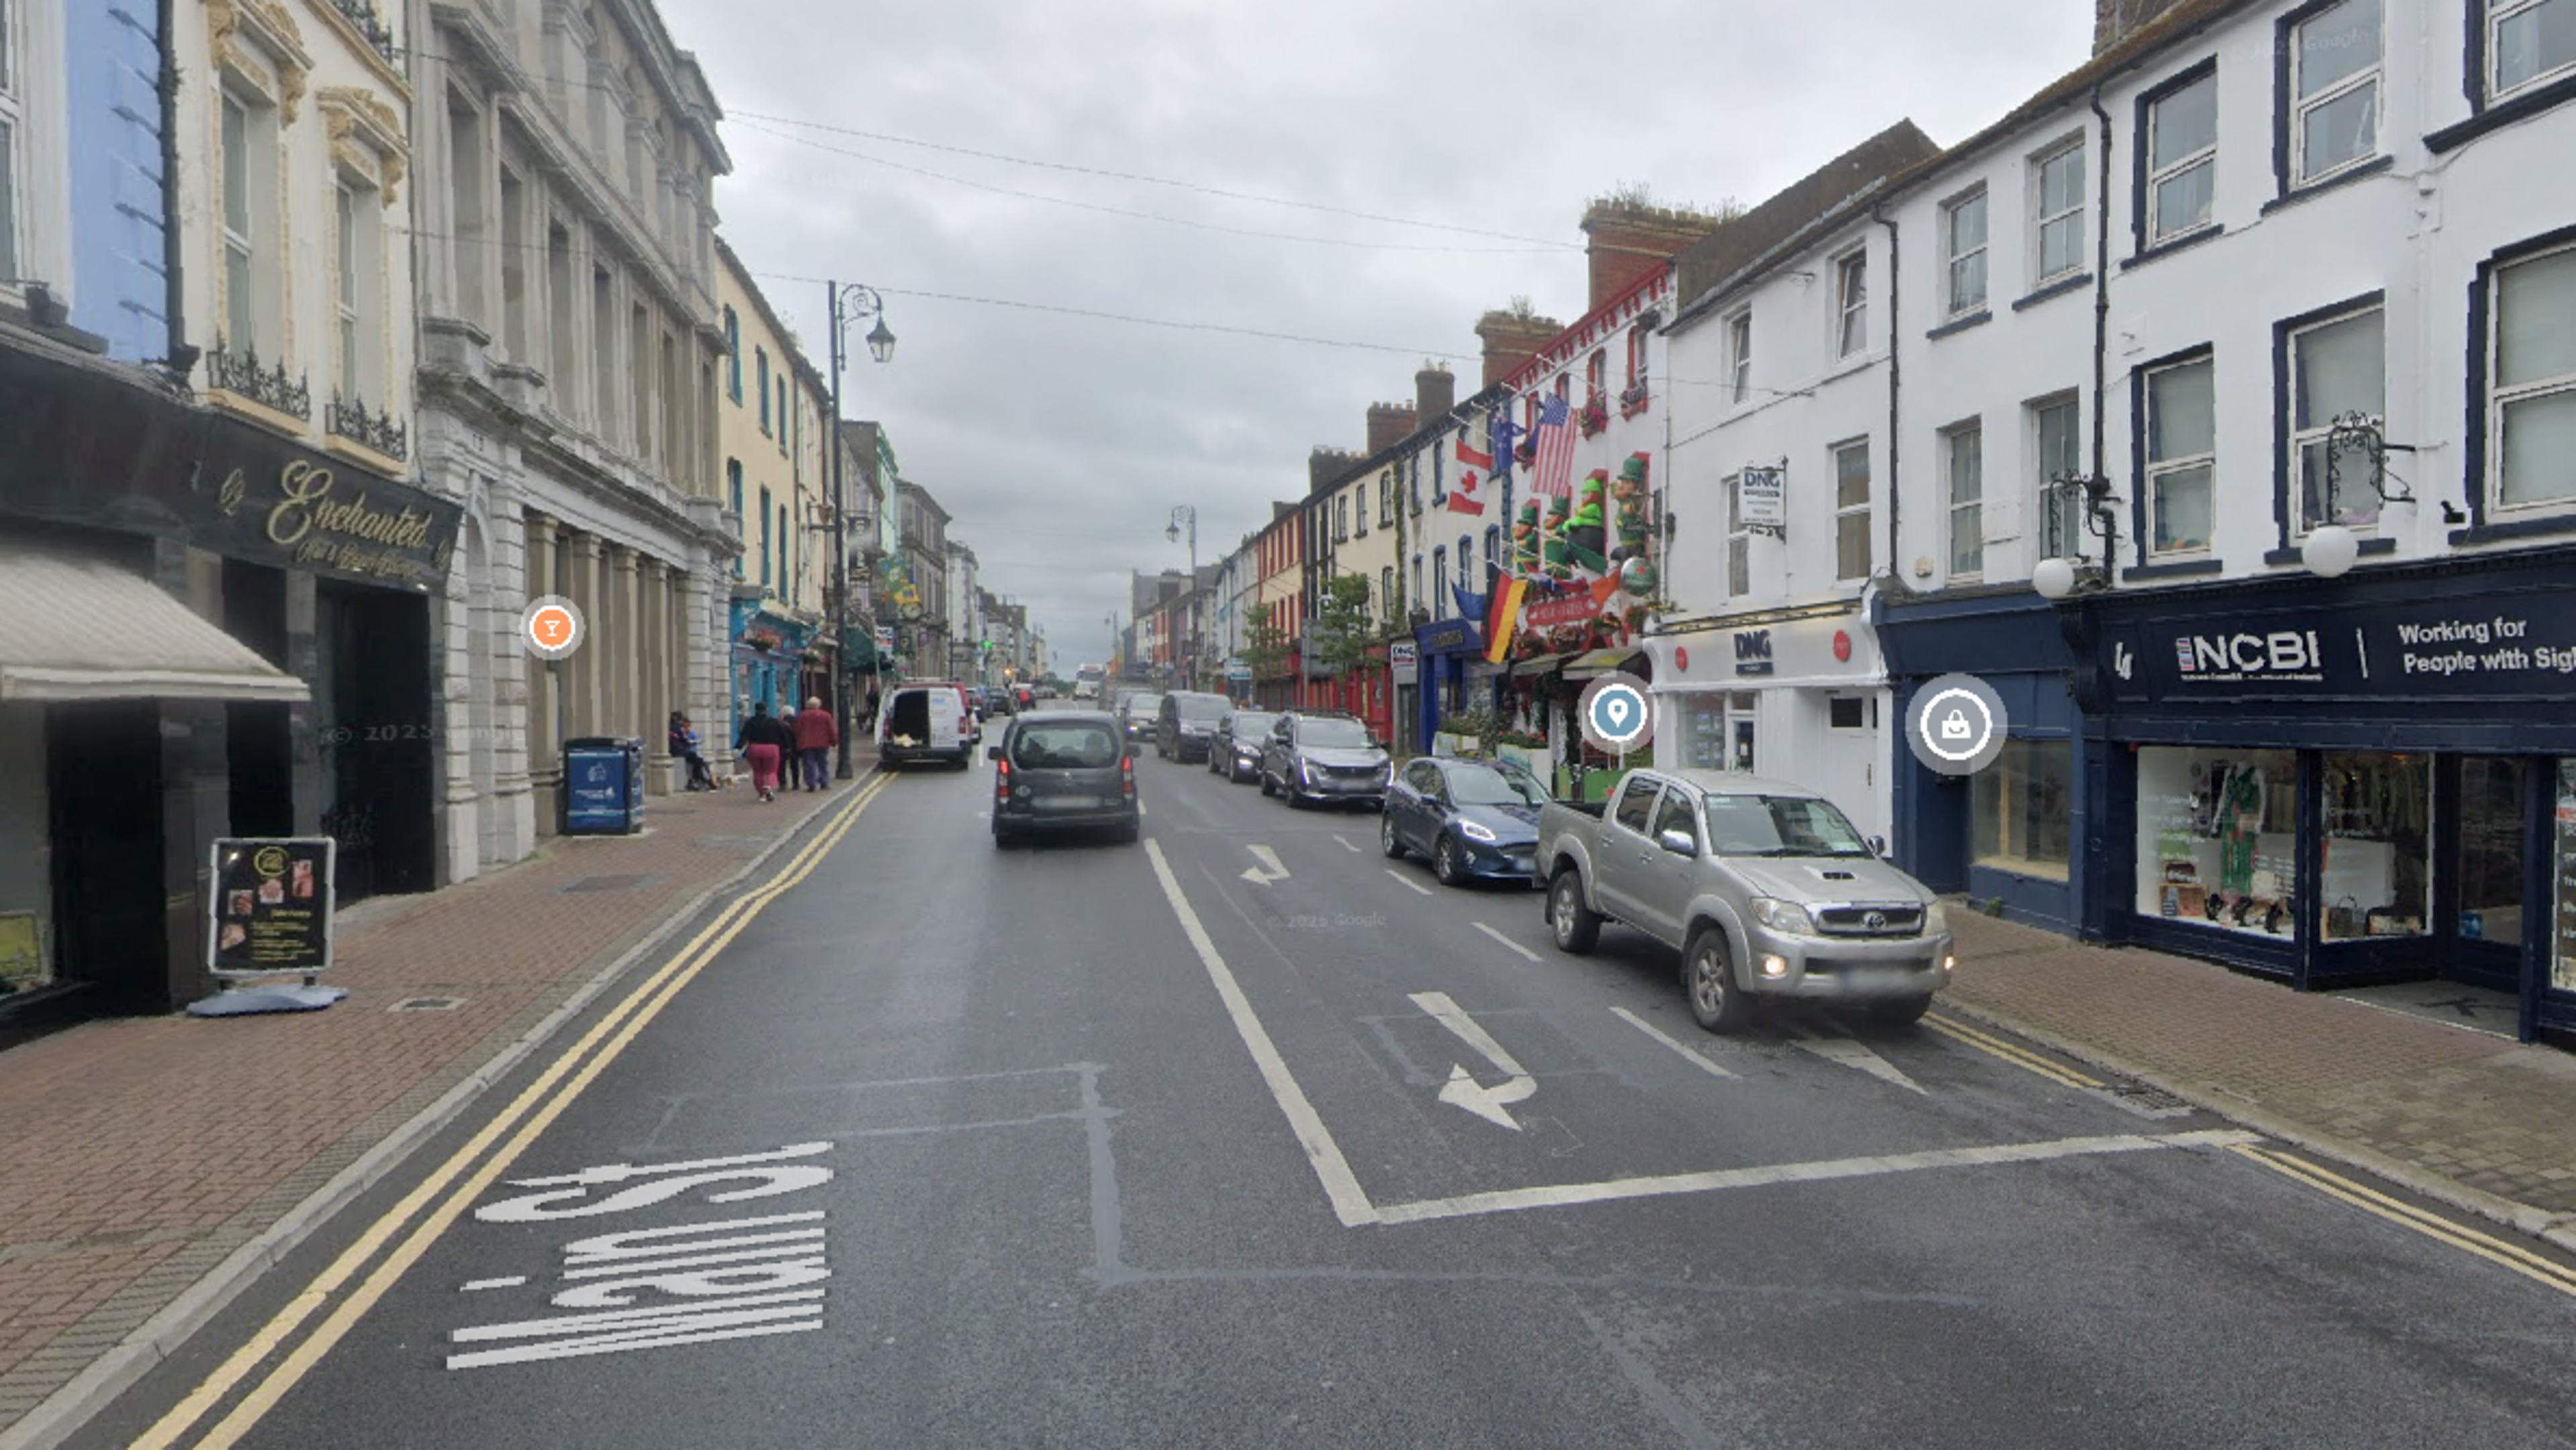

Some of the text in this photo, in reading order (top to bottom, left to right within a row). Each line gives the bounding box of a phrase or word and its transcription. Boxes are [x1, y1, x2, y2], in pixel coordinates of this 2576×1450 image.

[1744, 472, 1780, 487] DNG
[268, 460, 433, 548] Enchanted
[2398, 616, 2526, 644] Working for
[1734, 630, 1772, 660] DNG
[2193, 631, 2321, 671] NCBI
[2404, 650, 2477, 675] People
[2481, 648, 2529, 669] with
